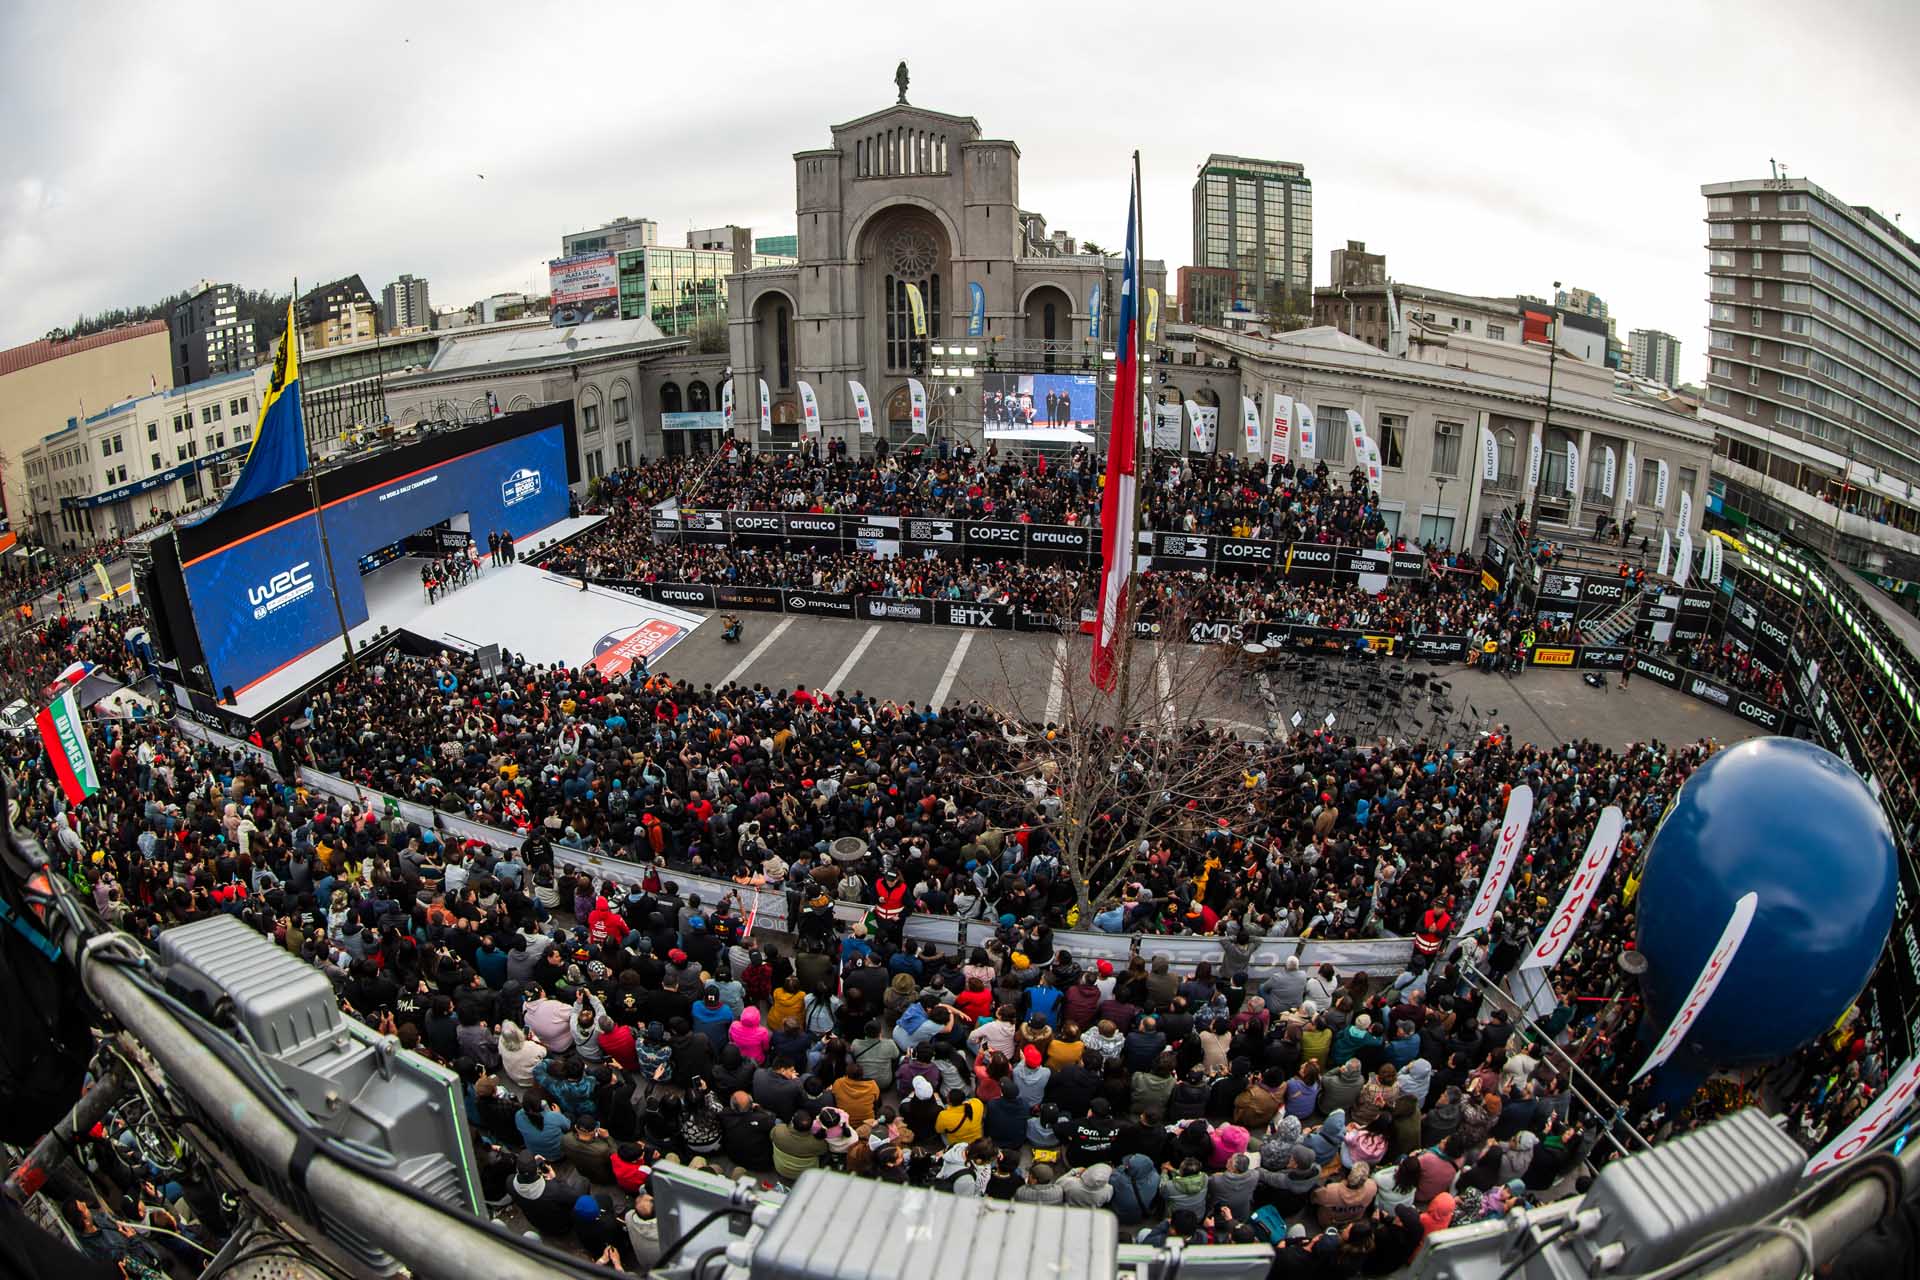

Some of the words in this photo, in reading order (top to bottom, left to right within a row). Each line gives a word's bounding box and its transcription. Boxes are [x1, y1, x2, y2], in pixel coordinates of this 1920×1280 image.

[735, 517, 779, 529] COPEC
[790, 517, 836, 531] arauco
[969, 527, 1020, 541] COPEC
[1032, 532, 1083, 545] arauco
[1223, 544, 1271, 559] COPEC
[1395, 561, 1421, 570] arauco
[248, 561, 312, 606] WRC
[604, 585, 642, 598] OPEC
[661, 590, 704, 601] arauco
[1588, 584, 1622, 598] COPEC
[808, 601, 850, 610] MAXUS
[1684, 598, 1710, 608] arauco
[1760, 621, 1788, 647] COPEC
[1536, 651, 1572, 662] PIRELLI
[1637, 660, 1675, 681] arauco
[1751, 658, 1776, 679] COPE
[1739, 701, 1776, 726] COPEC
[55, 715, 86, 774] ШУМЕН
